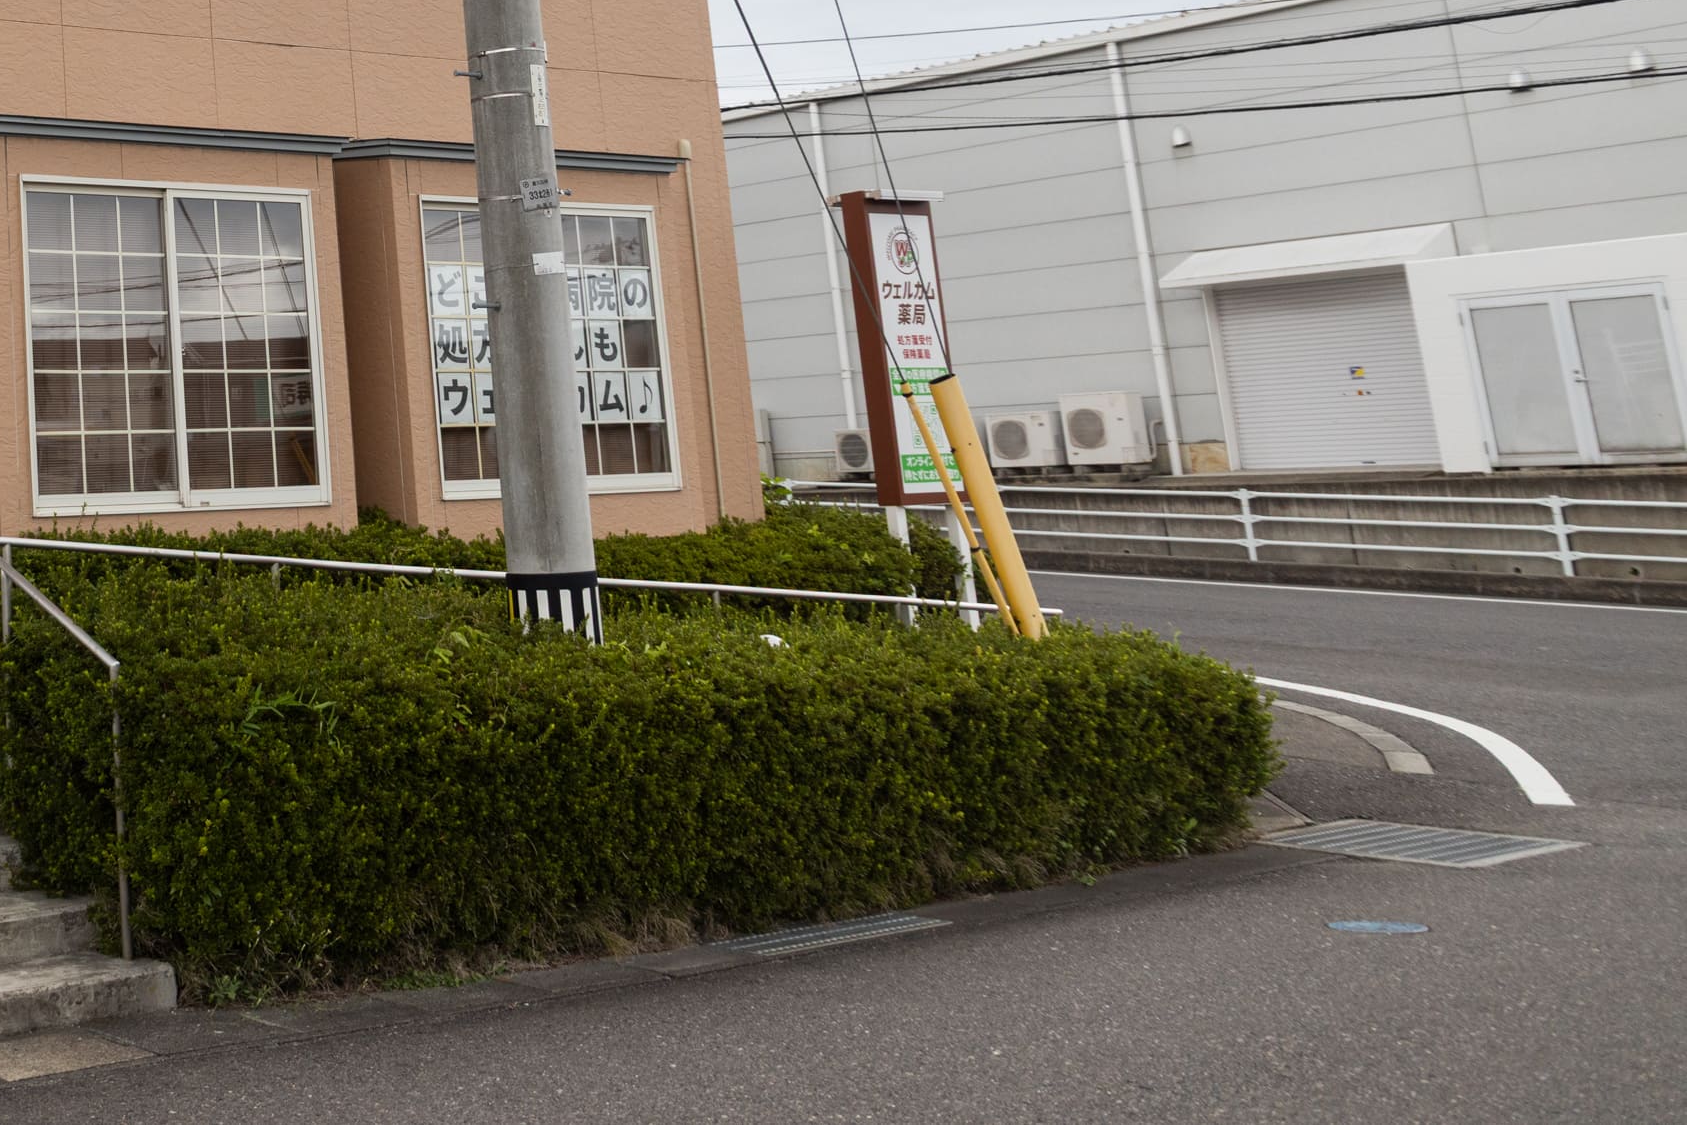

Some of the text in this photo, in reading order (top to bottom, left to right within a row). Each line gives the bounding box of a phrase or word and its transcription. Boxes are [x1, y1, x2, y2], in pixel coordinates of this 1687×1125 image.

[882, 280, 936, 300] ウェルカム
[898, 303, 926, 325] 薬局
